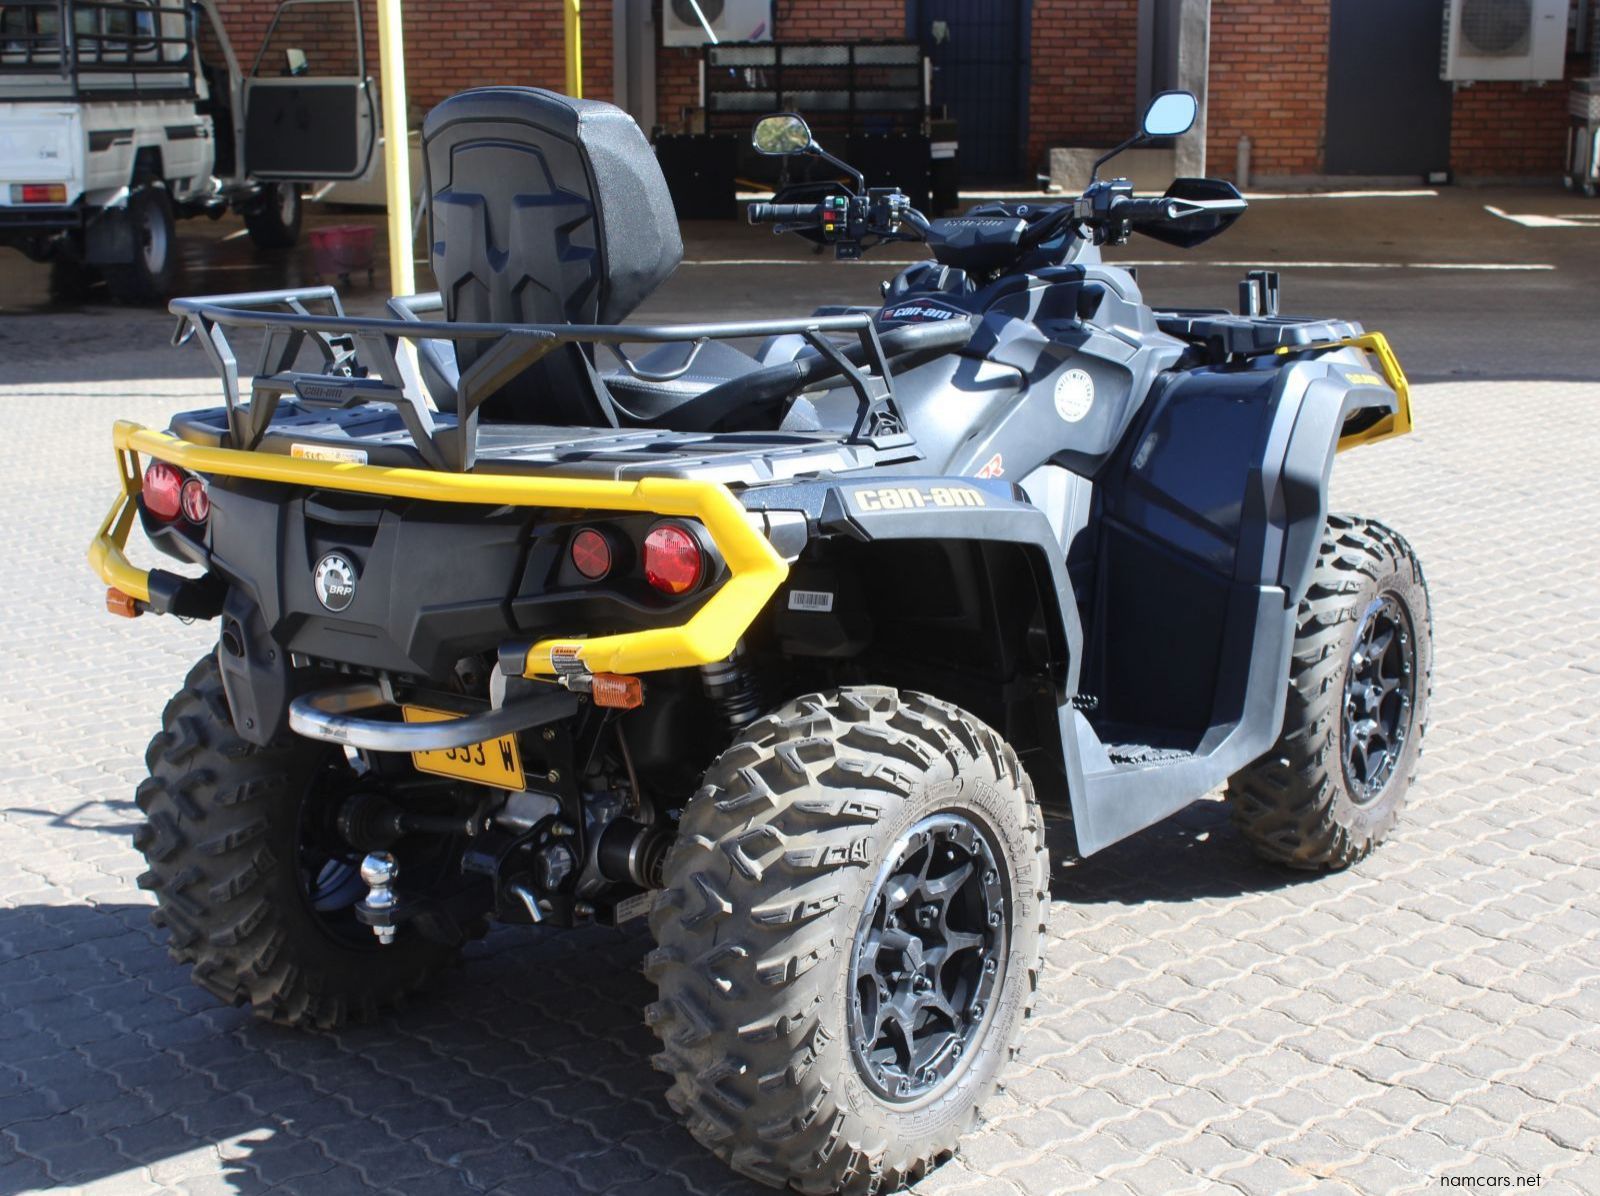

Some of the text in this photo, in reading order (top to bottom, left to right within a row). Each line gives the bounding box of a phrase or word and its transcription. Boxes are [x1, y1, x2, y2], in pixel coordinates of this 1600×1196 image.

[893, 307, 952, 320] can-am
[855, 487, 986, 511] can-am
[329, 585, 352, 595] BRP
[498, 740, 515, 772] W
